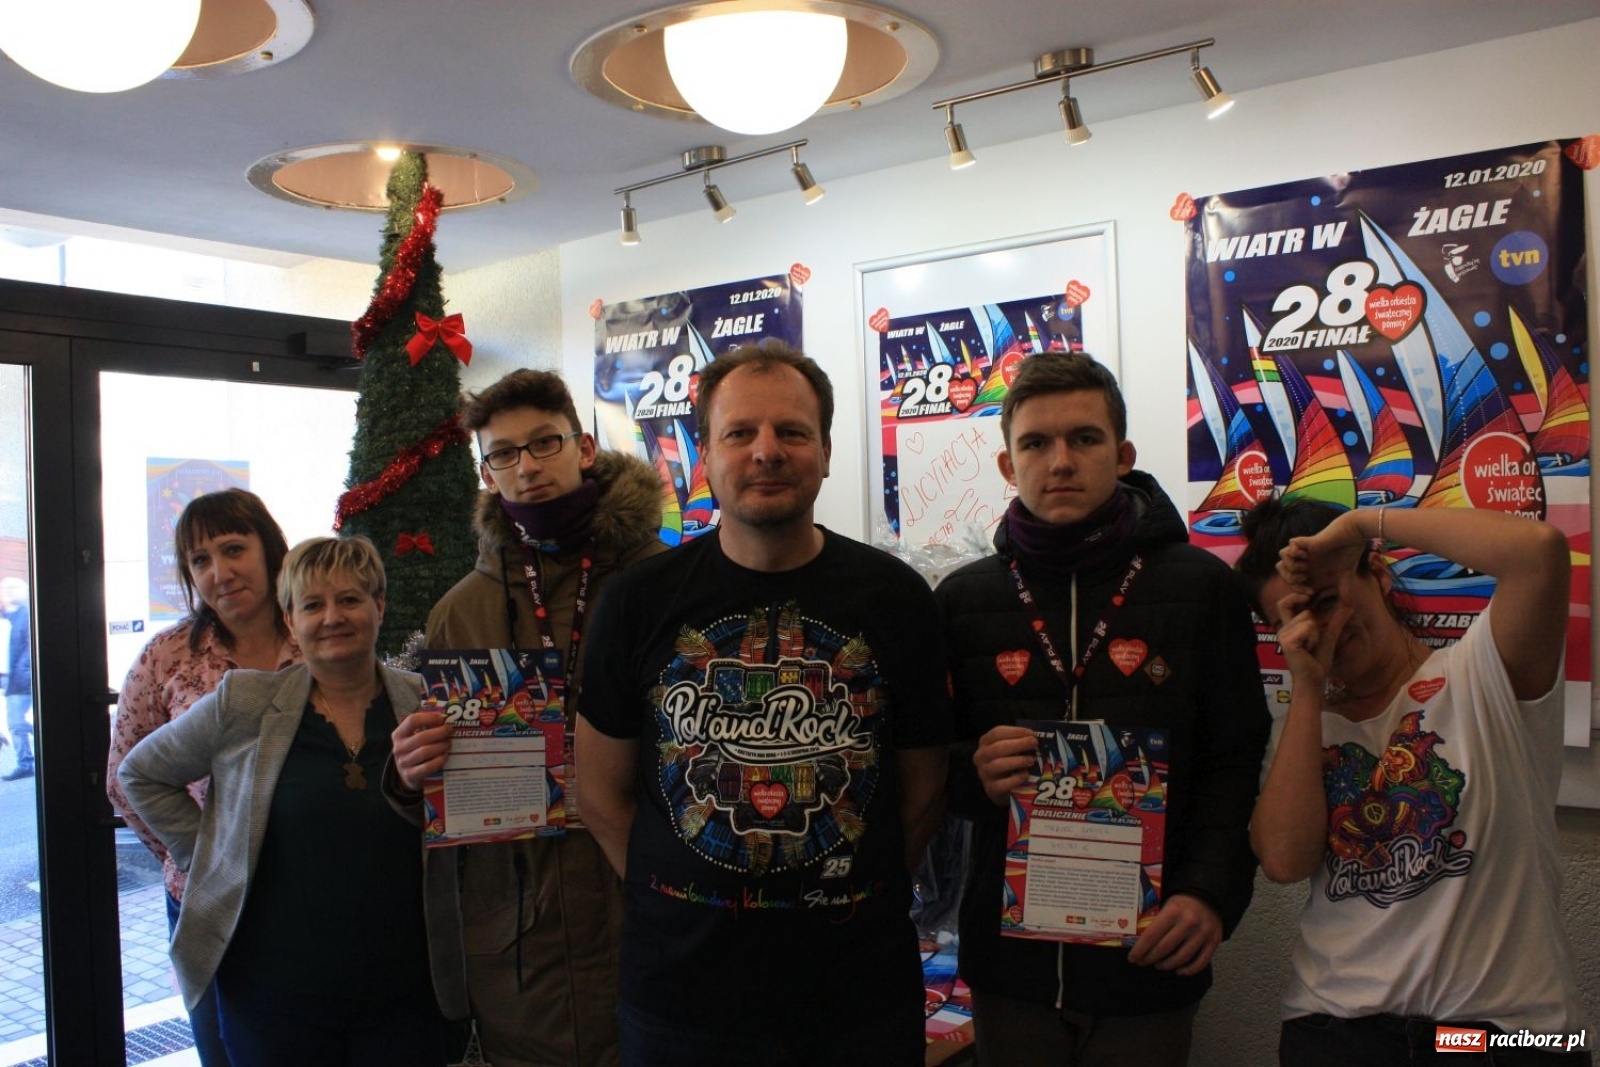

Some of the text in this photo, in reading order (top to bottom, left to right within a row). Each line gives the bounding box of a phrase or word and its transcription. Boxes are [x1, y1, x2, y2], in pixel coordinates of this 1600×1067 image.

[1443, 159, 1548, 189] 12.01.2020
[1407, 198, 1512, 238] ŻAGLE
[1206, 221, 1348, 264] WIATR W
[1498, 247, 1541, 269] tvn
[729, 286, 782, 305] 12.01.2020
[1265, 261, 1375, 348] 28
[711, 313, 765, 339] ŻAGLE
[887, 326, 926, 339] WIATR W
[939, 320, 965, 333] ŻAGLE
[1267, 325, 1372, 349] 2020 FINAŁ
[605, 325, 681, 354] WIATR W
[637, 355, 696, 414] 28
[902, 364, 954, 412] 28
[636, 400, 693, 418] 2020 FINAŁ
[918, 401, 952, 416] FINAŁ
[1474, 453, 1520, 478] wielka
[1249, 474, 1274, 487] świątec
[1487, 480, 1543, 507] świątec
[444, 698, 482, 723] 28
[1034, 776, 1077, 802] 28
[1031, 809, 1087, 821] ROZLICZENIE
[820, 855, 853, 879] 25
